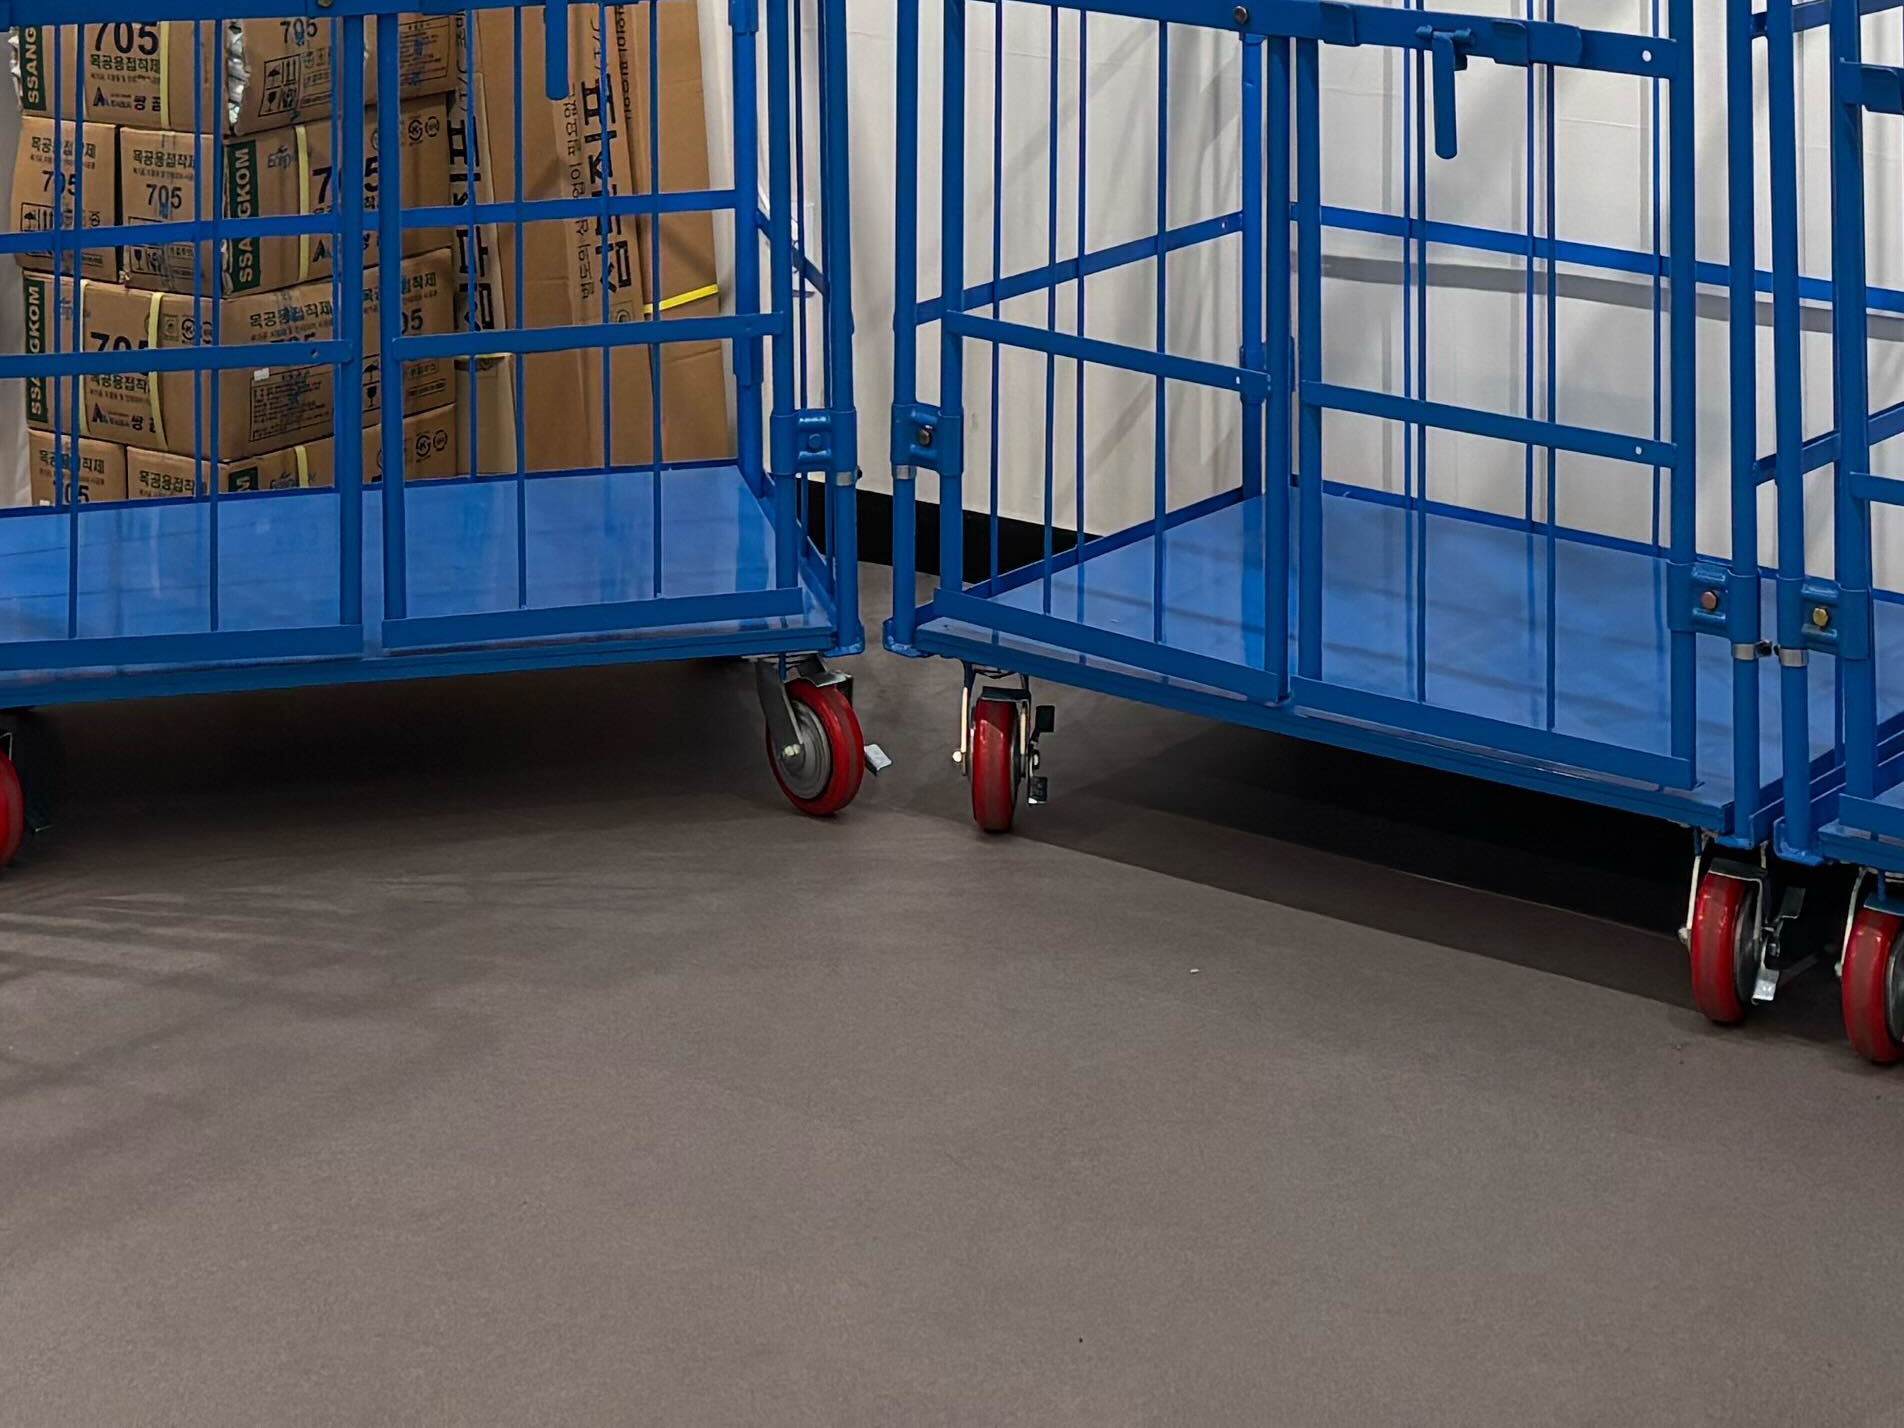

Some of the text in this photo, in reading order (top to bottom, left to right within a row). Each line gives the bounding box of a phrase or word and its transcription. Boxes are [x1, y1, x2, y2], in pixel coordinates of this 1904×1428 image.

[94, 21, 160, 55] 705
[280, 18, 318, 44] 705
[146, 184, 183, 209] 705
[312, 156, 378, 204] 75
[235, 148, 254, 283] SSAGKOM
[569, 161, 592, 237] 심업이
[139, 470, 196, 493] 목공용접착
